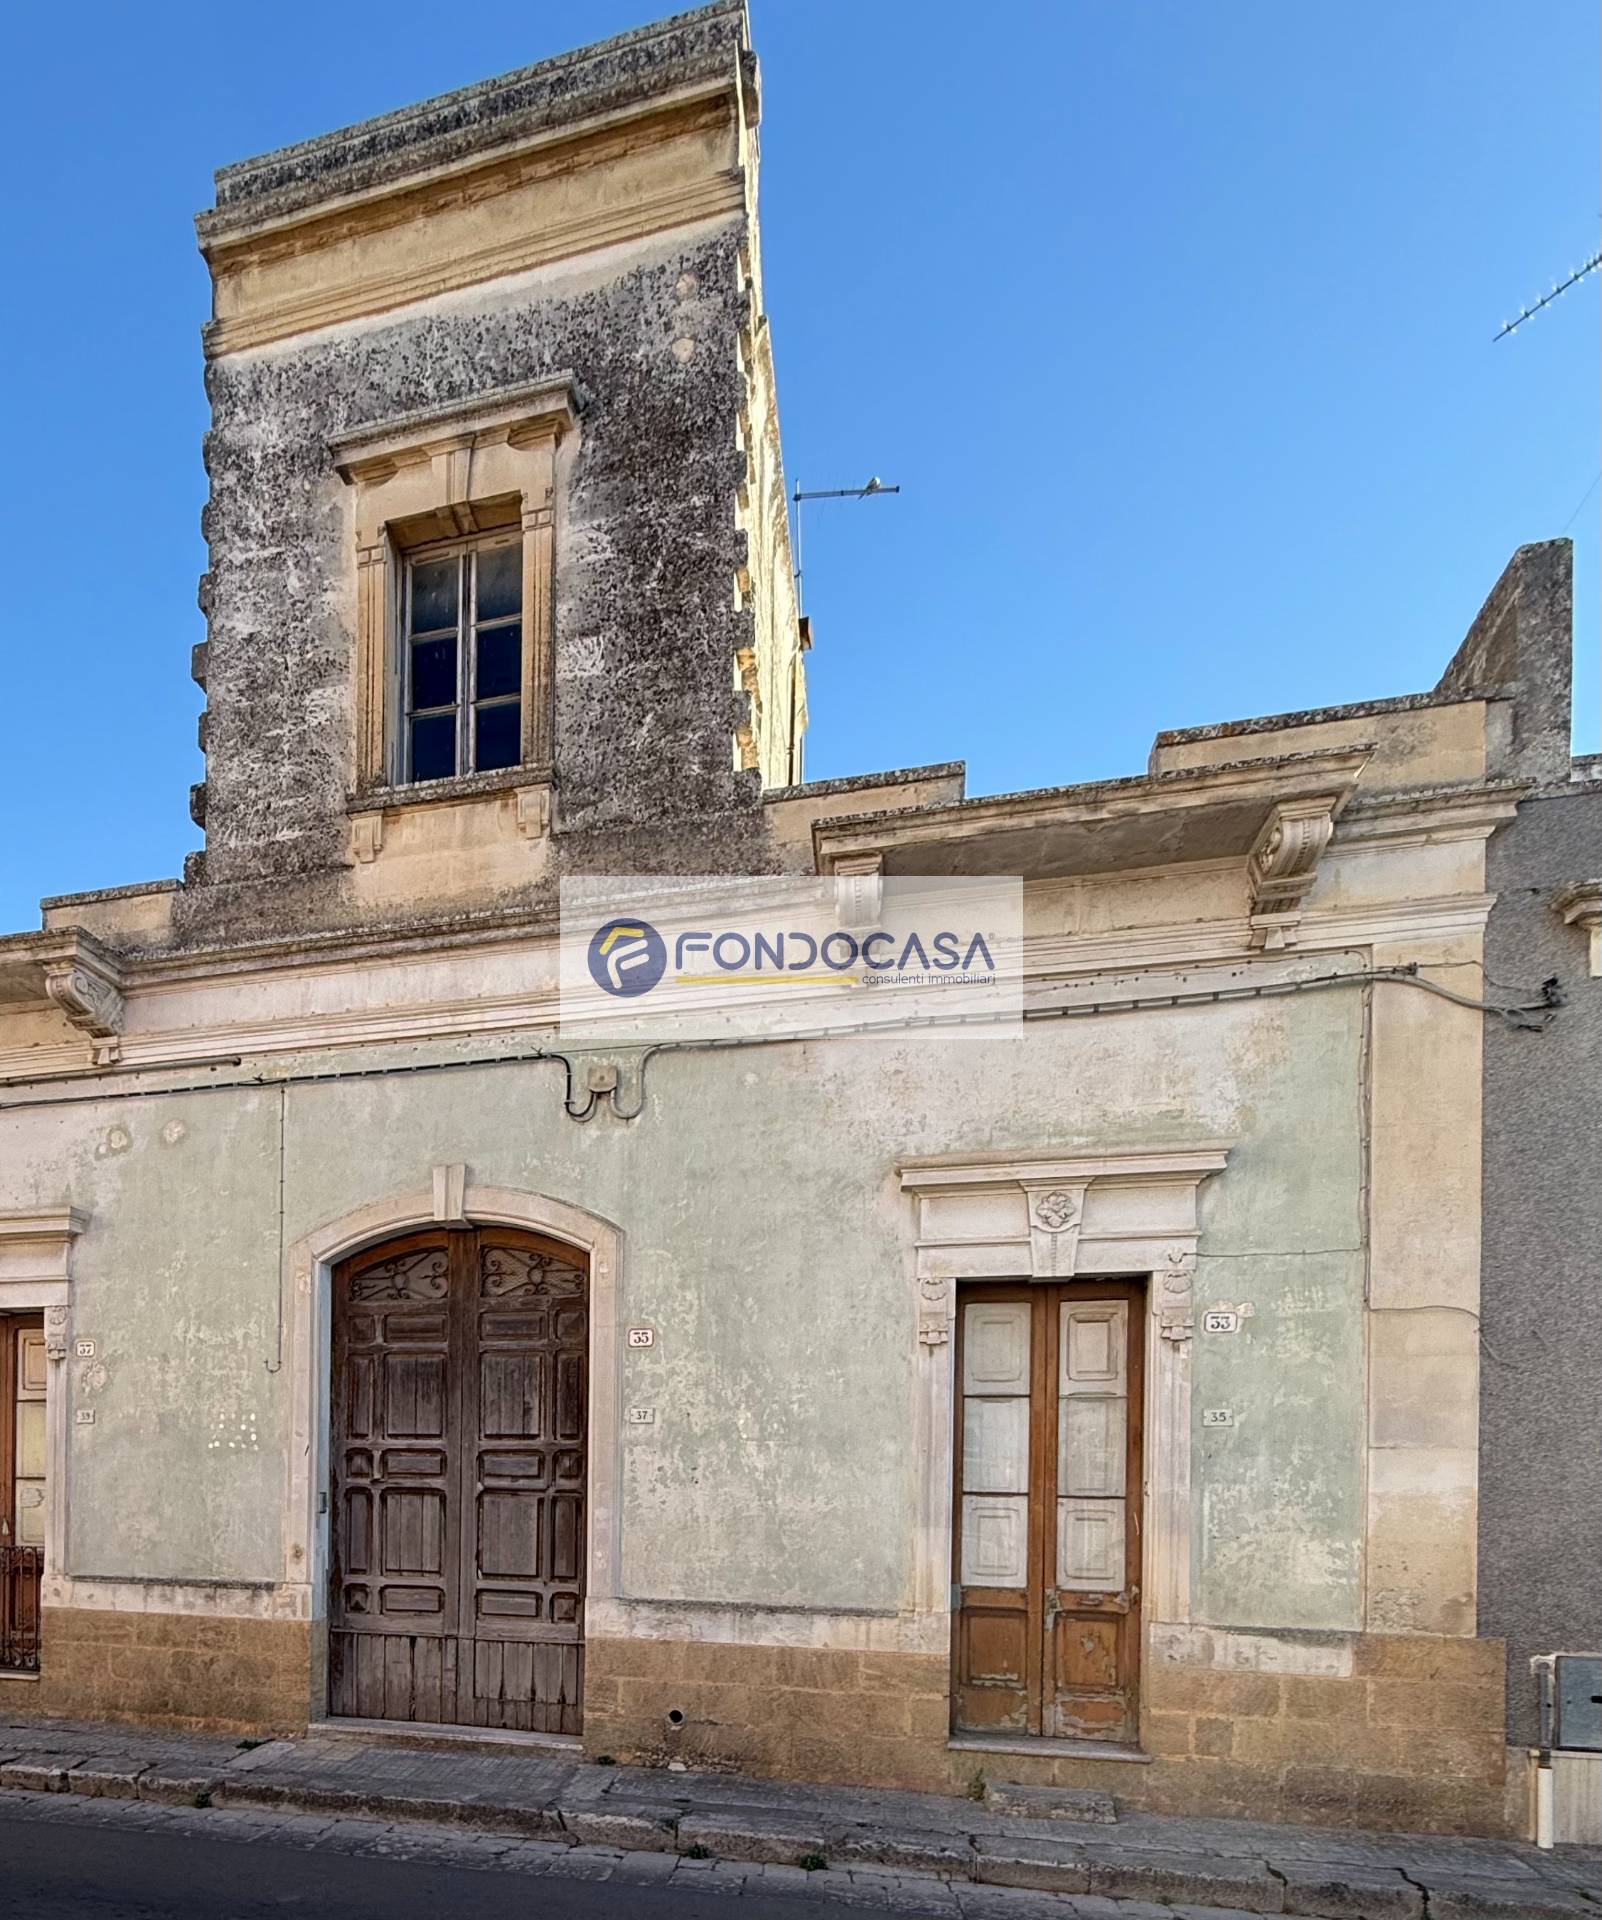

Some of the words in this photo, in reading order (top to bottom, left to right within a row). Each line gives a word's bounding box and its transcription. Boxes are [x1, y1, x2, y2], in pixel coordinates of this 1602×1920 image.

[1210, 1316, 1230, 1329] 33
[633, 1332, 649, 1343] 35
[80, 1344, 91, 1354] 37
[636, 1411, 647, 1419] 37
[1210, 1412, 1226, 1422] 35
